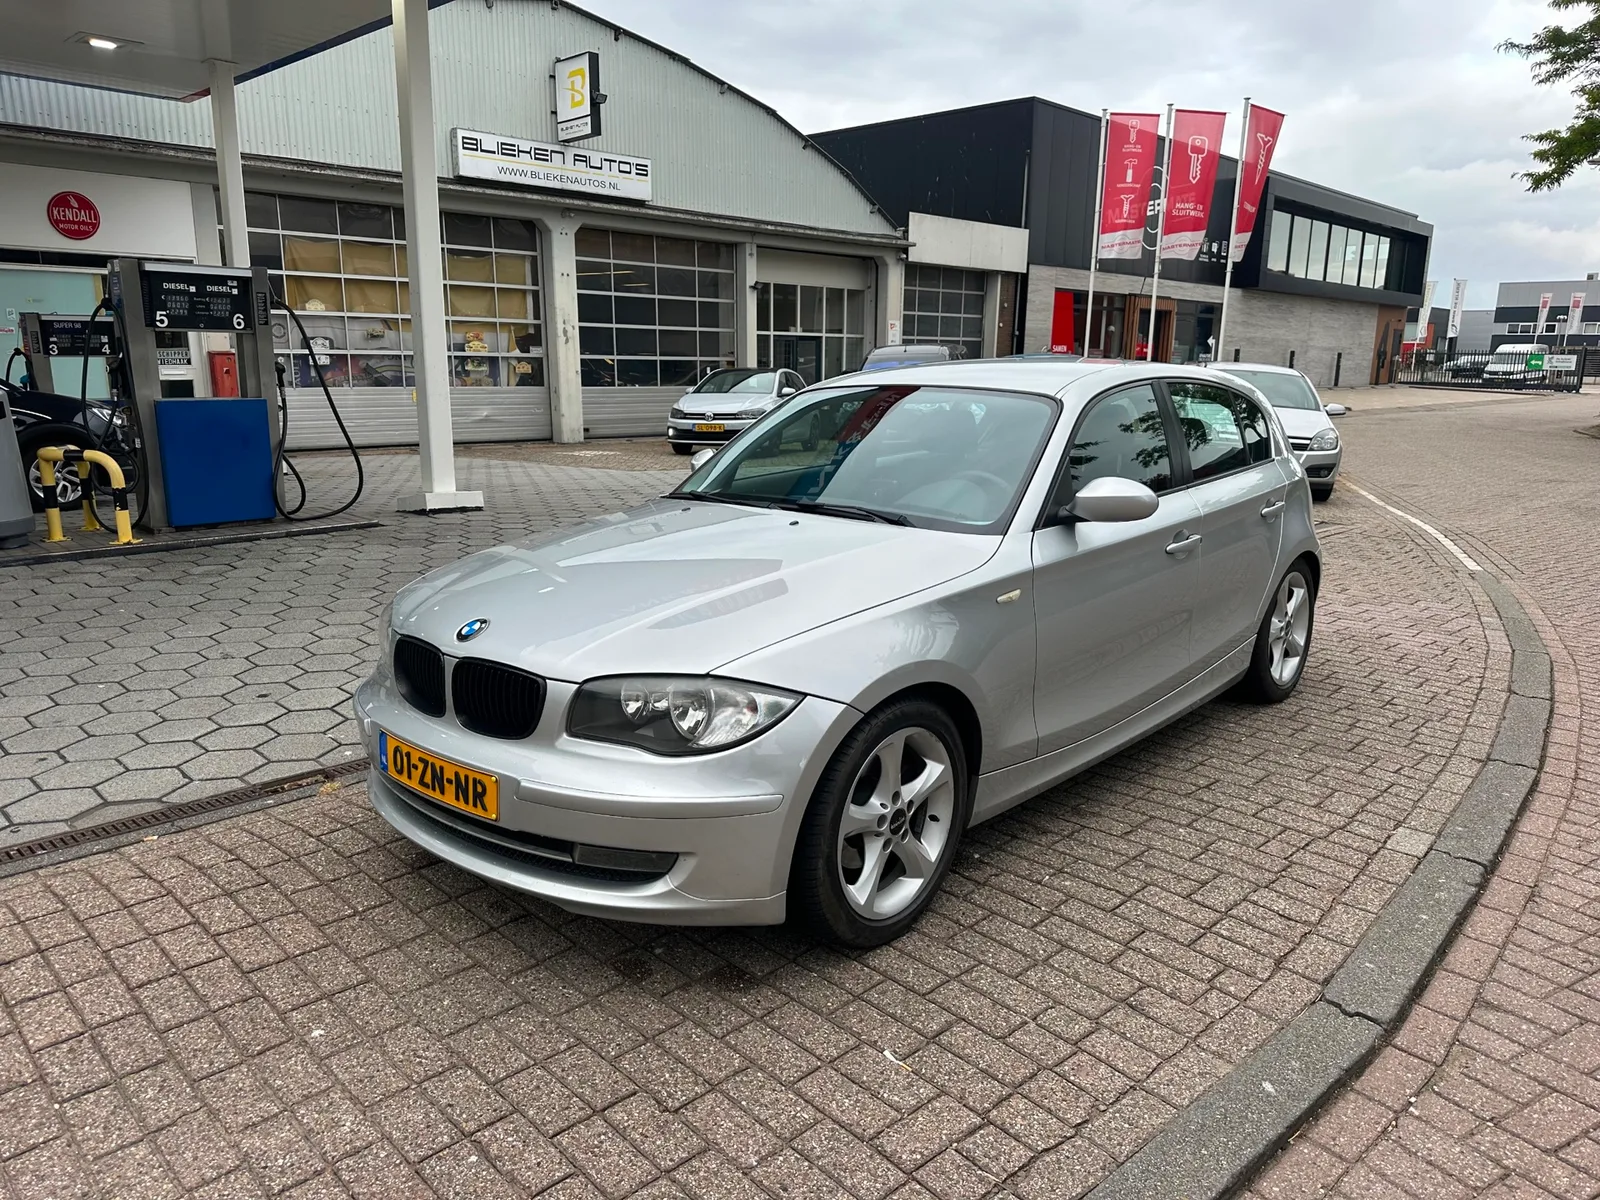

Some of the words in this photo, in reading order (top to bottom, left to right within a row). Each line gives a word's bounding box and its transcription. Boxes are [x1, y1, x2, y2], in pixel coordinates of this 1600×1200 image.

[462, 136, 565, 165] BLIEKEN
[573, 153, 649, 177] AUTO'S
[497, 166, 621, 191] WWW.BLIEKENAUTOS.NL
[52, 206, 97, 223] KENDALL
[163, 282, 190, 290] DIESEL
[206, 285, 232, 293] DIESEL
[155, 311, 169, 328] 5
[233, 313, 245, 330] 6
[49, 344, 59, 355] 3
[101, 344, 111, 355] 4
[393, 745, 488, 812] 01-ZN-NR
